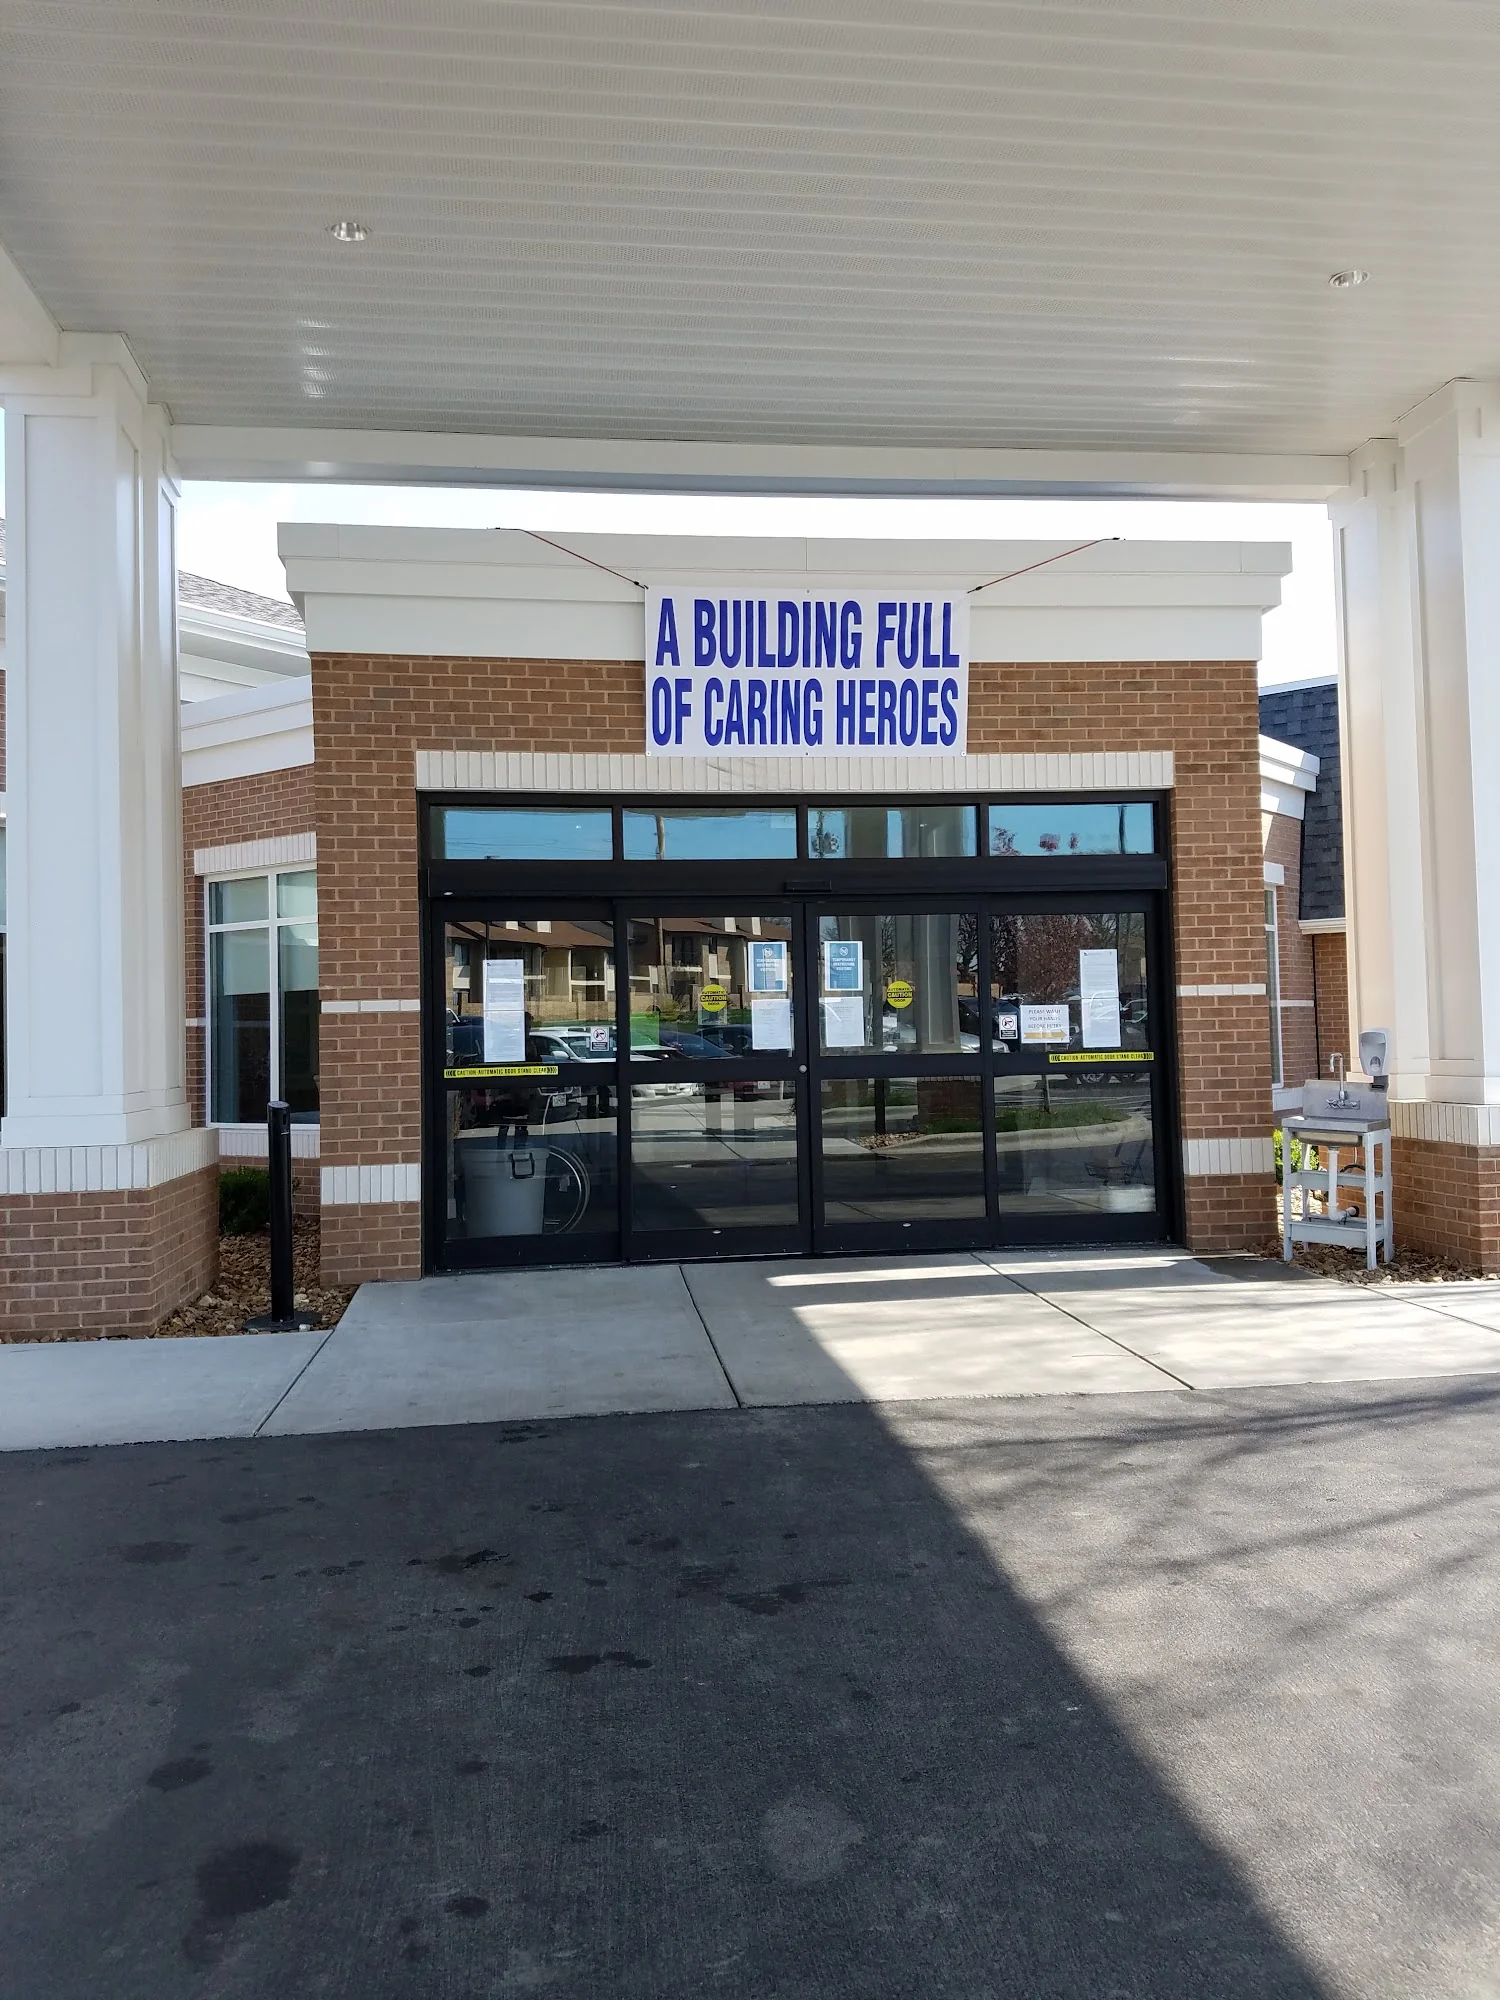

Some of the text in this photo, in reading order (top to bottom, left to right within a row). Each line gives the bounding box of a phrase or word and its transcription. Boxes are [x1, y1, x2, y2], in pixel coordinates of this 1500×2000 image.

[655, 598, 960, 669] A BUILDING FULL
[652, 676, 959, 747] OF CARING HEROES
